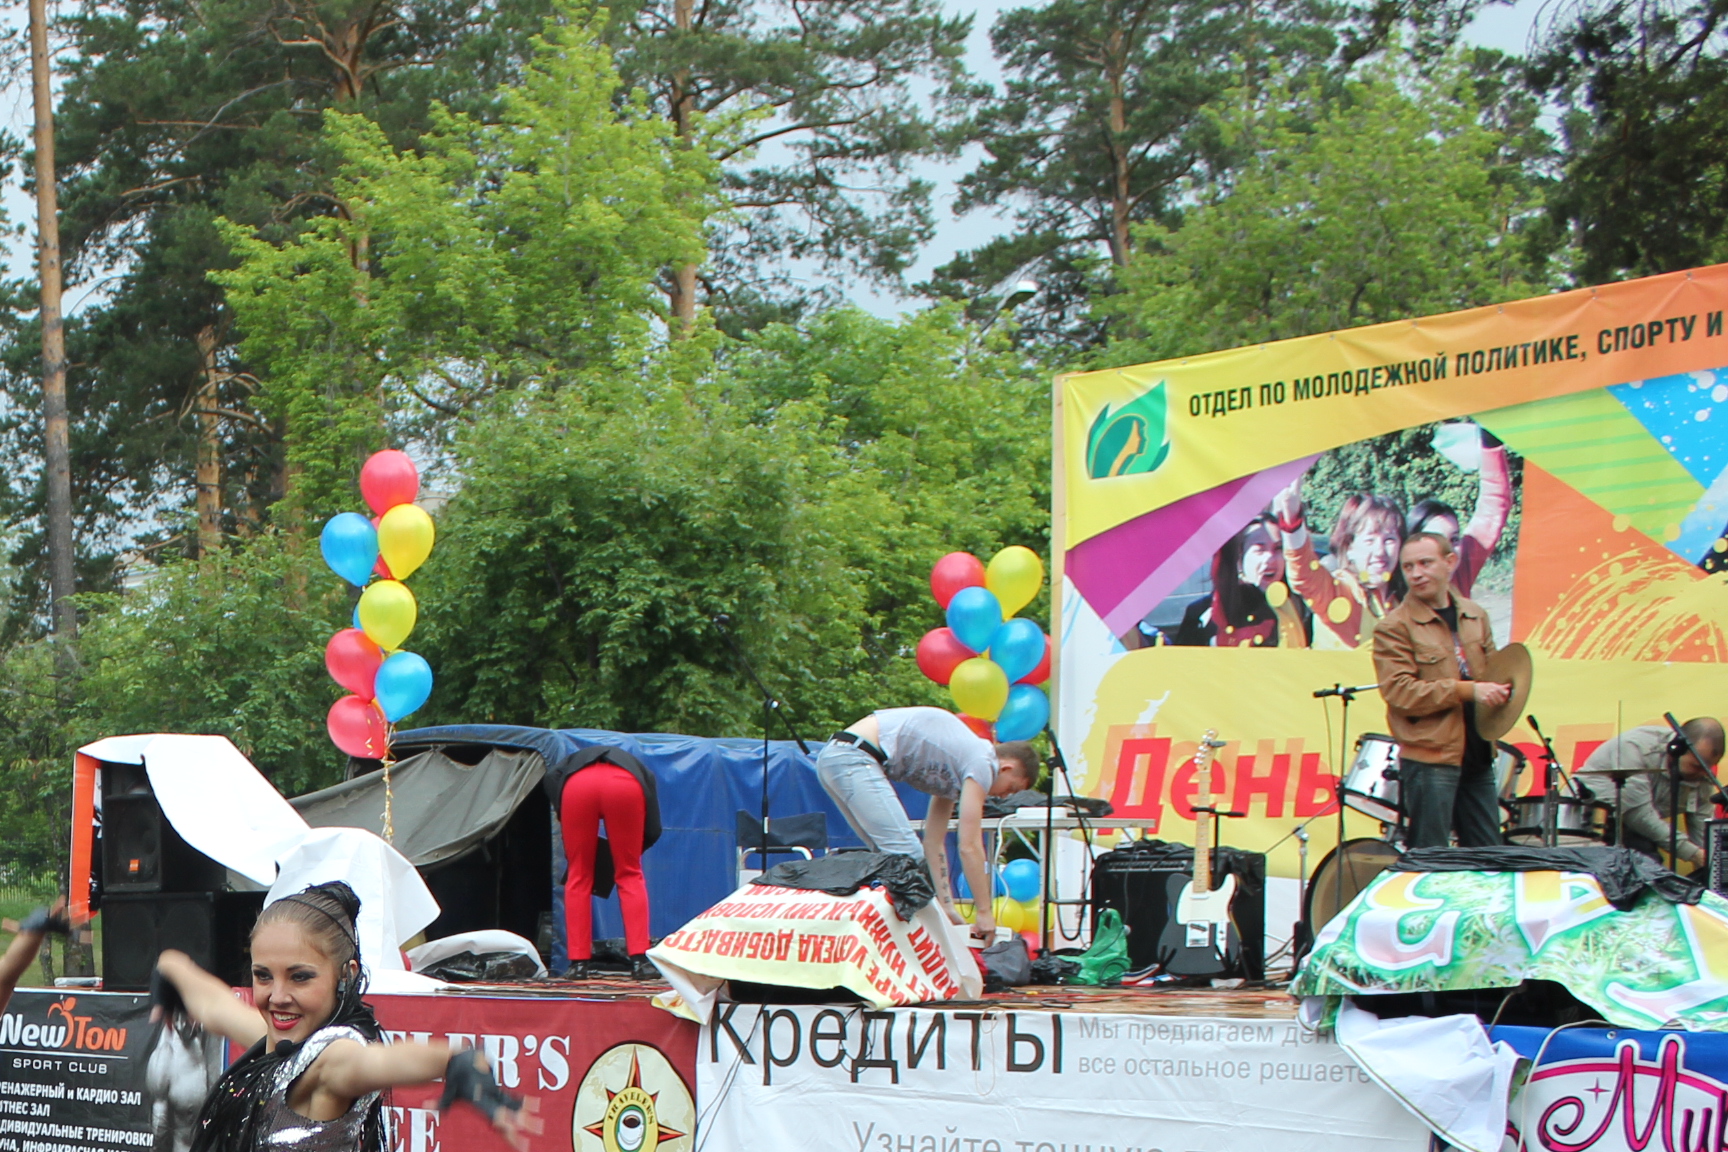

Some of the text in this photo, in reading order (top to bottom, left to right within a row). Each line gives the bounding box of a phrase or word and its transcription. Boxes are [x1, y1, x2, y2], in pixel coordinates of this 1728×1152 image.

[1189, 311, 1723, 418] ОТДЕЛ ПО МОЛОДЕЖНОЙ ПОЛИТИКЕ, СПОРТУ И
[1097, 736, 1342, 836] День
[1078, 1016, 1119, 1040] Мы
[1127, 1020, 1274, 1046] предлагаем
[710, 1002, 1063, 1086] Кредиты
[12, 1058, 108, 1074] SPORT CLUB
[1078, 1056, 1116, 1075] все
[1124, 1055, 1251, 1080] остальное
[76, 1087, 118, 1105] КАРДИО
[120, 1091, 142, 1106] ЗАЛ
[29, 1102, 51, 1117] ЗАЛ
[85, 1126, 154, 1147] ТРЕНИРОВКИ
